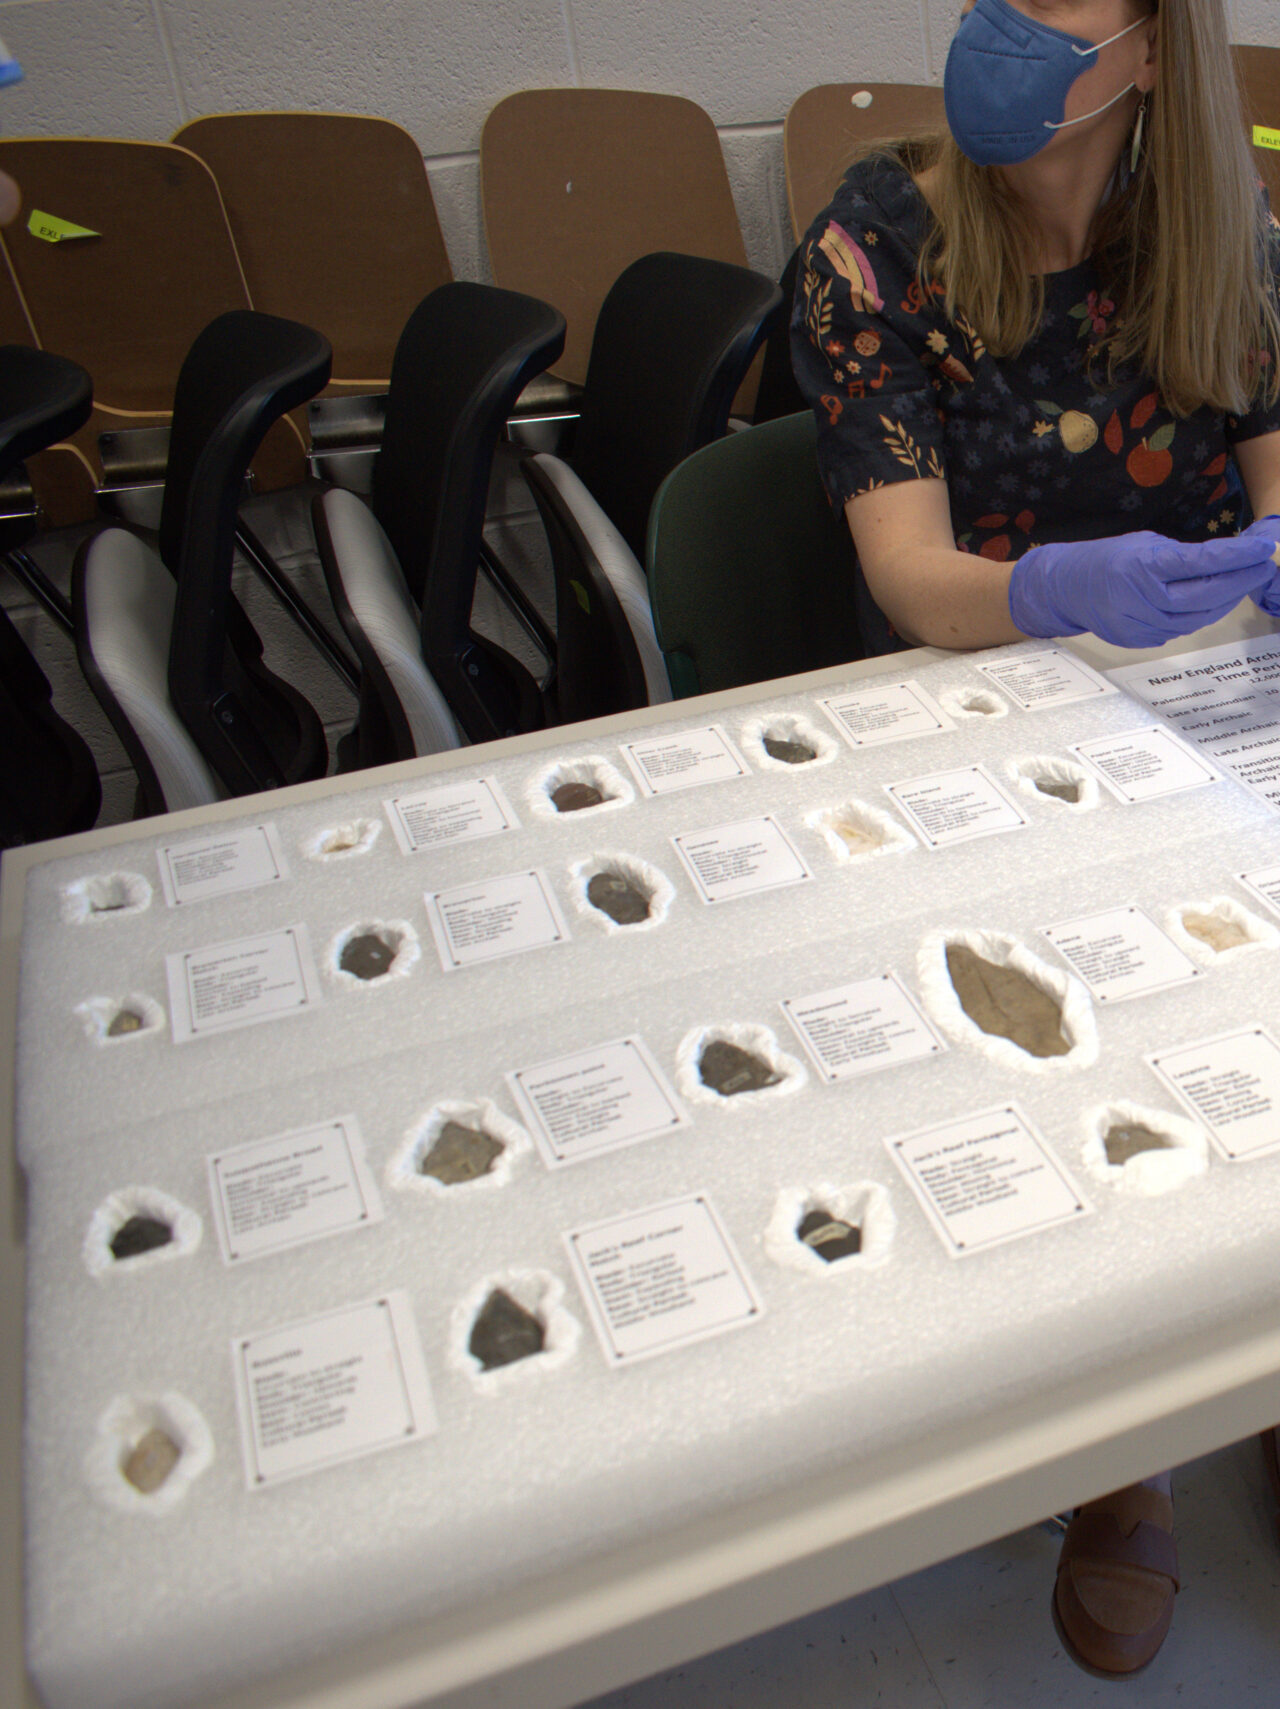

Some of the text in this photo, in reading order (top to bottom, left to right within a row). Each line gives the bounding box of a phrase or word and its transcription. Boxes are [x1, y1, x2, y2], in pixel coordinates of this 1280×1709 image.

[1148, 672, 1182, 687] New
[1185, 659, 1244, 678] England
[1212, 670, 1250, 684] Time
[1151, 688, 1215, 708] Paleoindian
[1166, 694, 1256, 720] Late Paleoindian
[1181, 711, 1253, 733] Early Archaic
[1198, 720, 1280, 745] Middle Archaic
[1213, 747, 1239, 758] Late
[1248, 774, 1277, 785] Early
